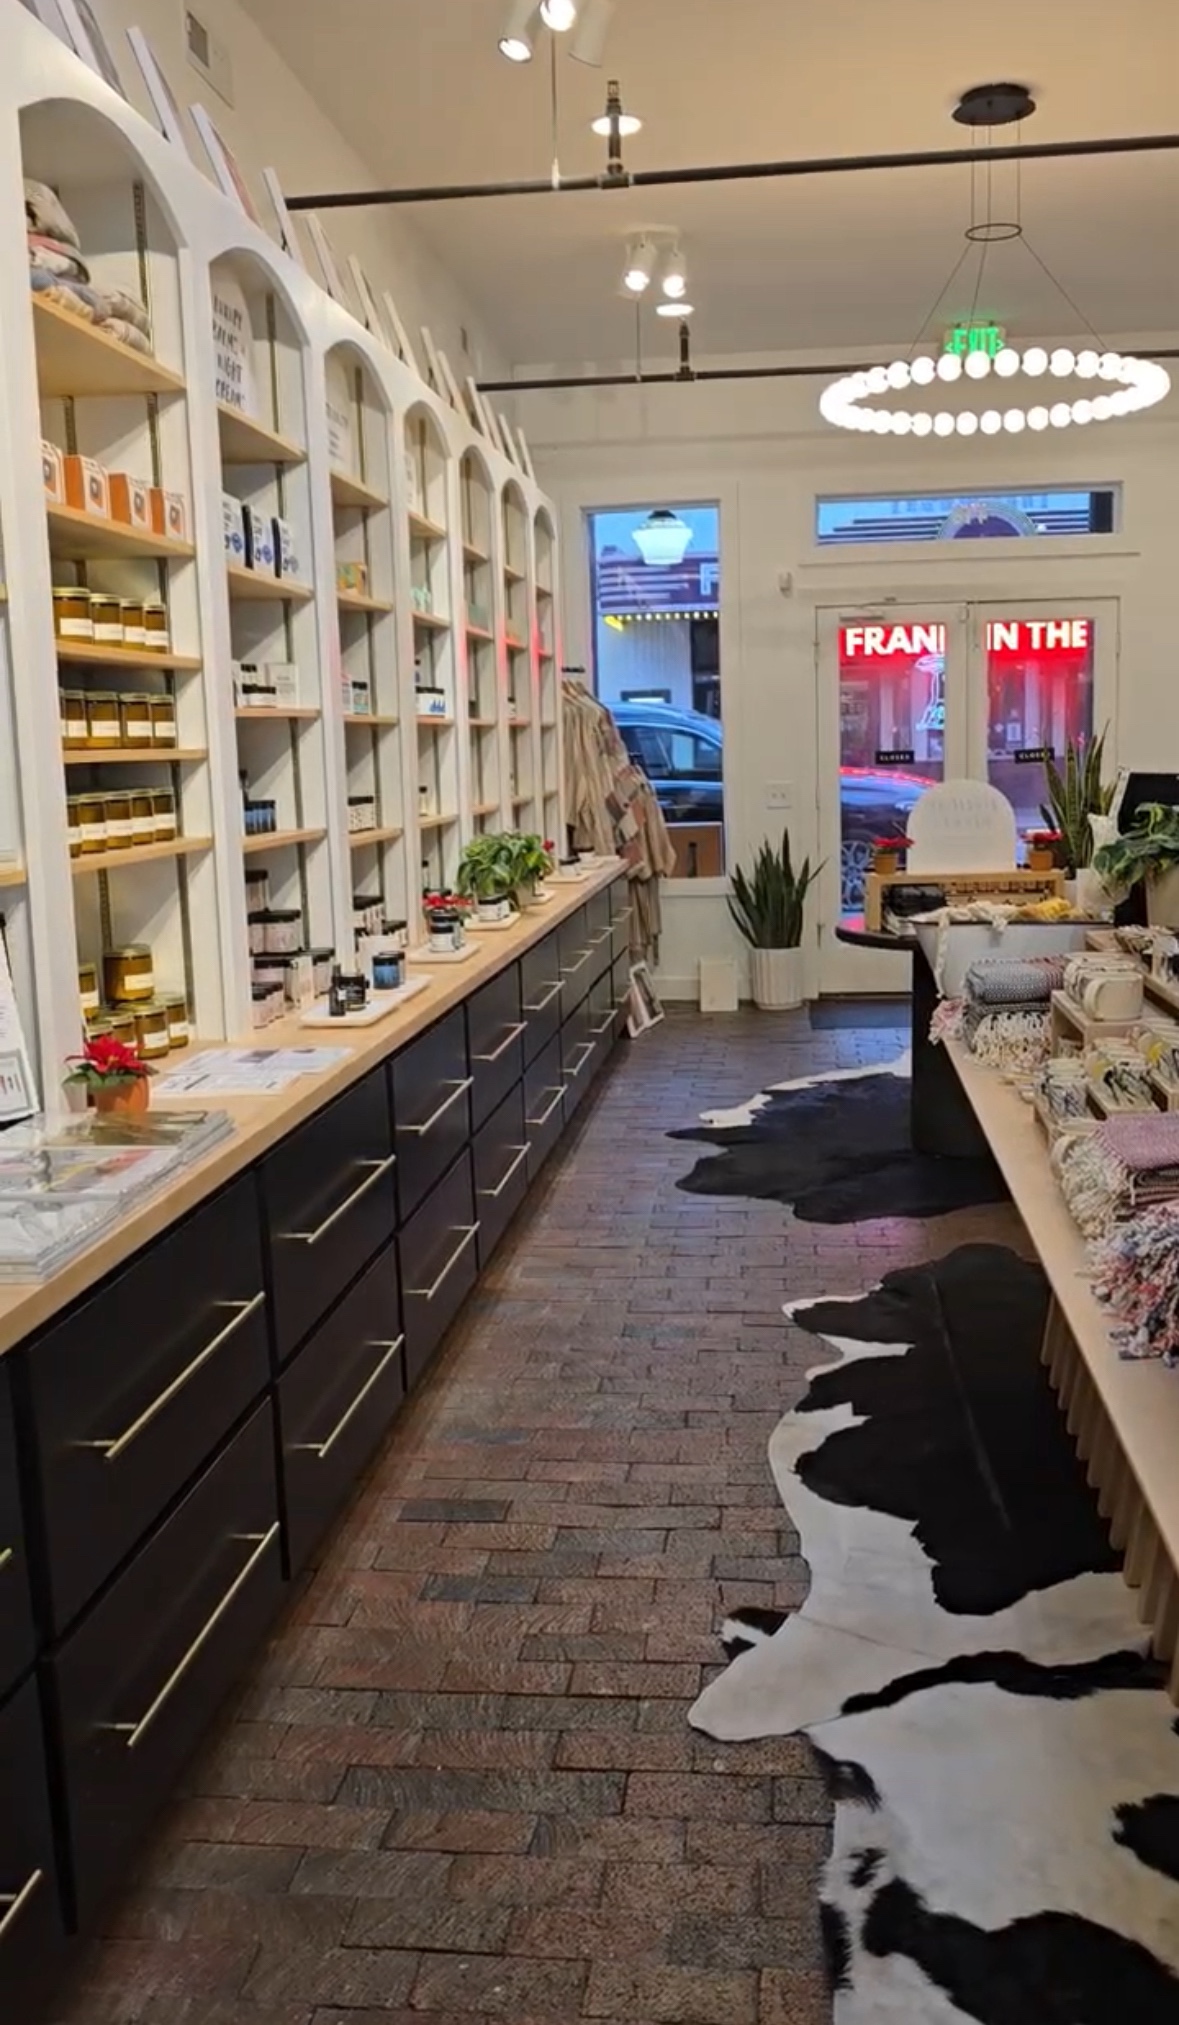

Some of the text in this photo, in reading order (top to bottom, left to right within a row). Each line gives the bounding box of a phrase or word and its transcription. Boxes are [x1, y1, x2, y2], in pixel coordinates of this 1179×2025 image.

[953, 328, 999, 358] EXIT
[1025, 620, 1087, 650] THE
[879, 754, 910, 762] CLOSED
